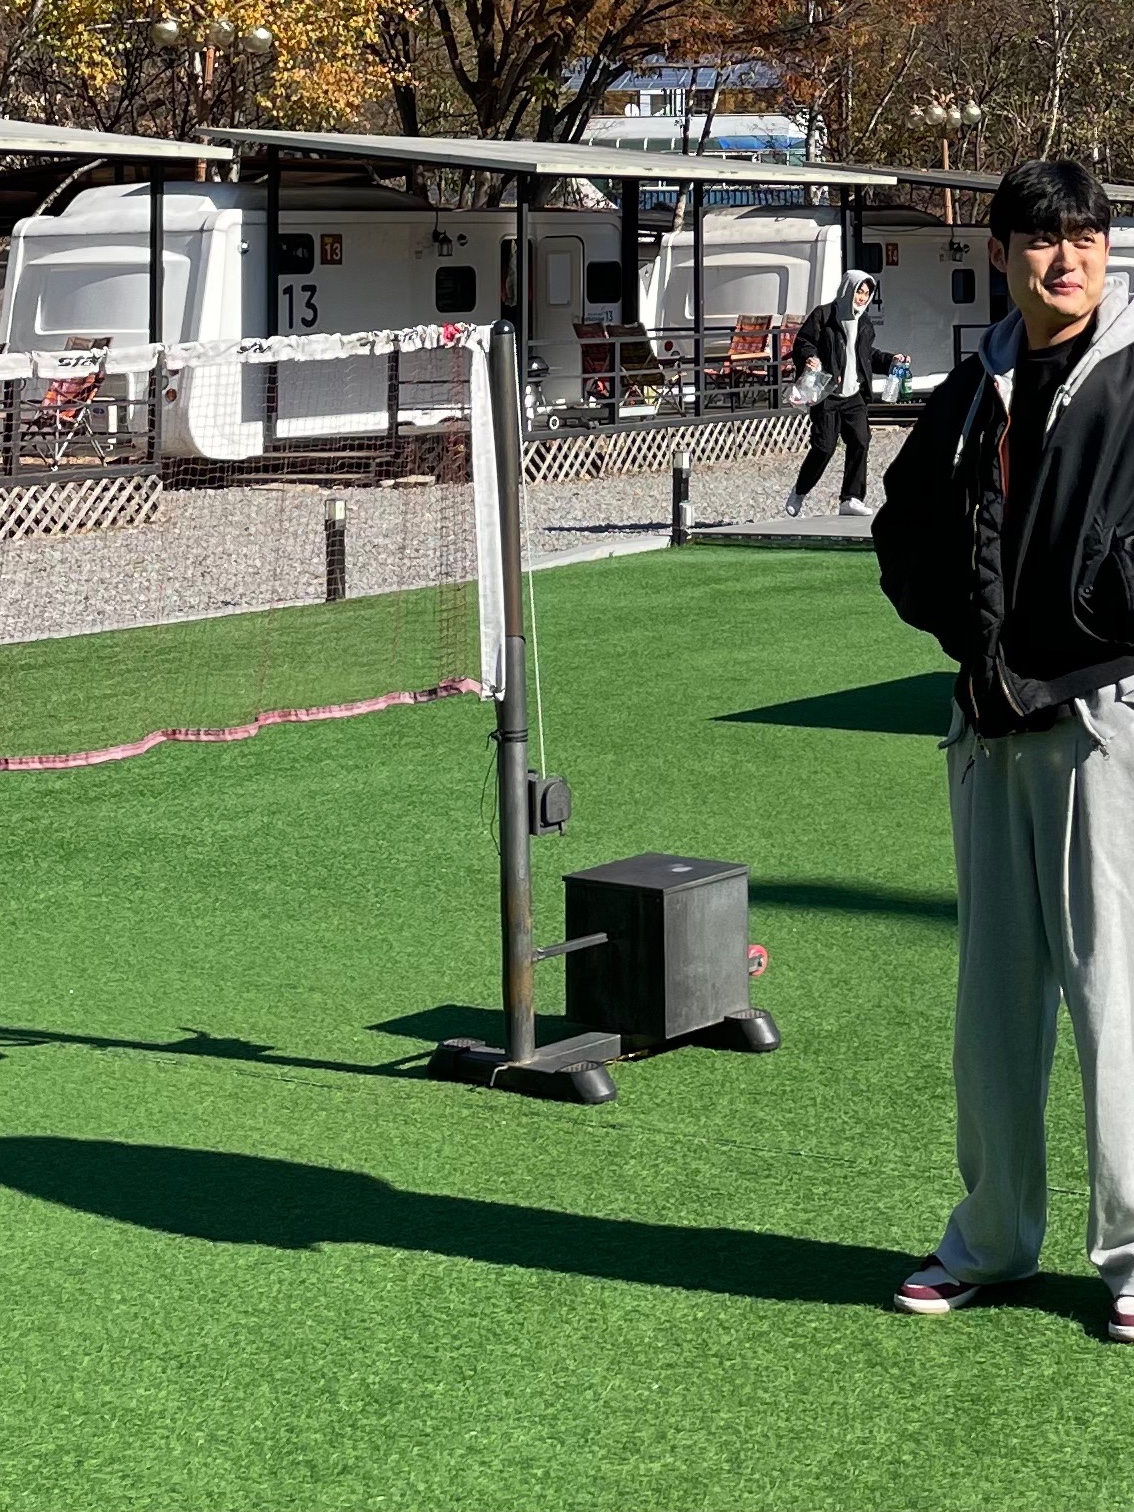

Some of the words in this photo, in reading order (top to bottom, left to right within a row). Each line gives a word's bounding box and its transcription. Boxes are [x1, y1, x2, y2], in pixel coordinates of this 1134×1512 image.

[325, 243, 341, 260] 13
[282, 284, 318, 329] 13
[866, 280, 883, 312] 4
[605, 310, 613, 322] 13
